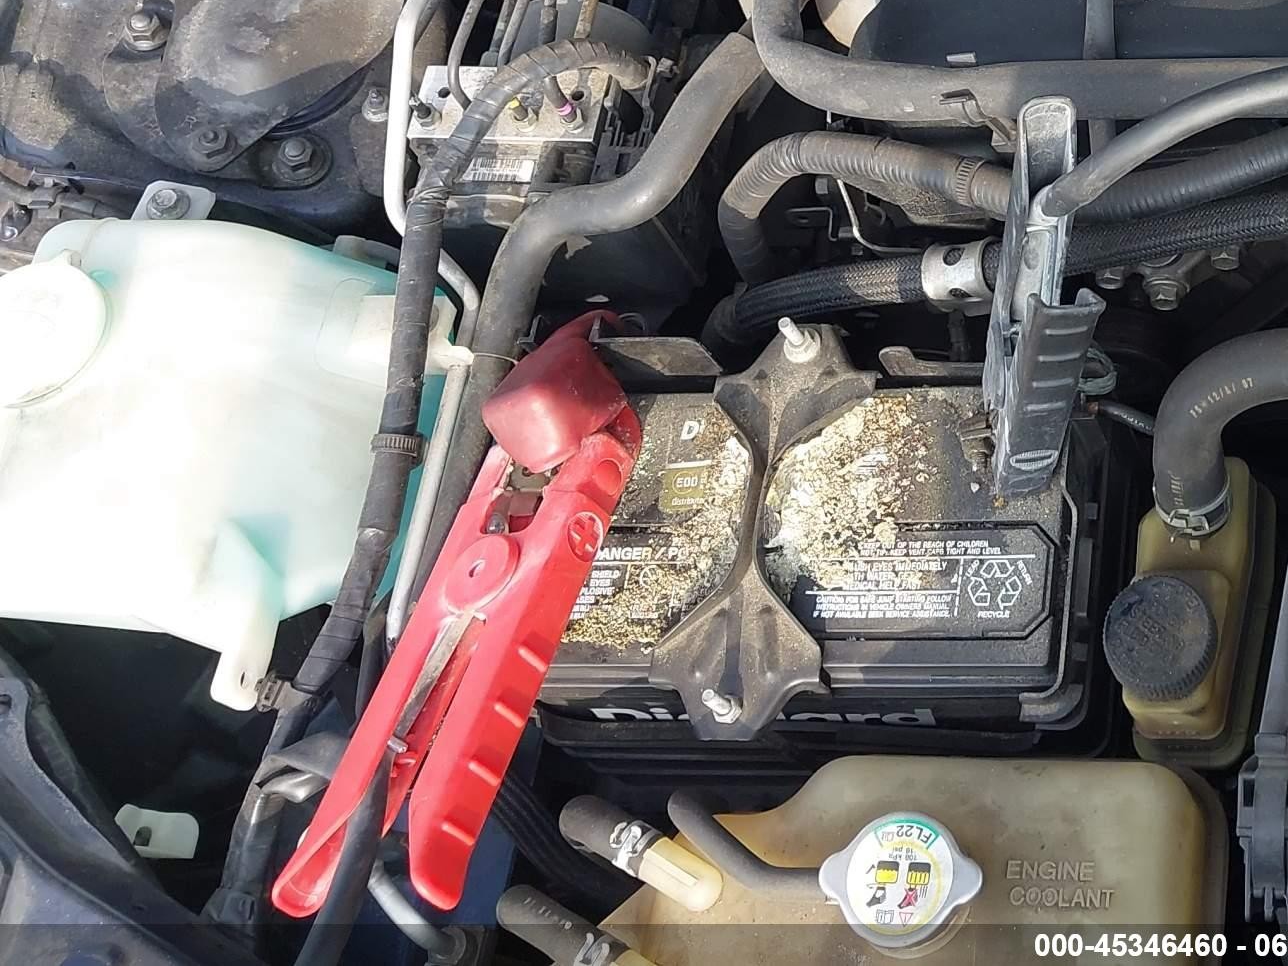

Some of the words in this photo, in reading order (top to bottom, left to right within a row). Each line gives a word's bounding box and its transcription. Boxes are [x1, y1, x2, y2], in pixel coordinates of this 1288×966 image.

[596, 546, 654, 561] ANGER
[922, 540, 945, 549] REACH
[956, 540, 989, 548] CHILDREN
[965, 559, 980, 578] LEAD
[1016, 559, 1034, 586] RETURN
[977, 610, 1011, 619] RECYCLE
[895, 824, 933, 845] FL22
[1005, 860, 1096, 883] ENGINE
[1009, 885, 1116, 910] COOLANT
